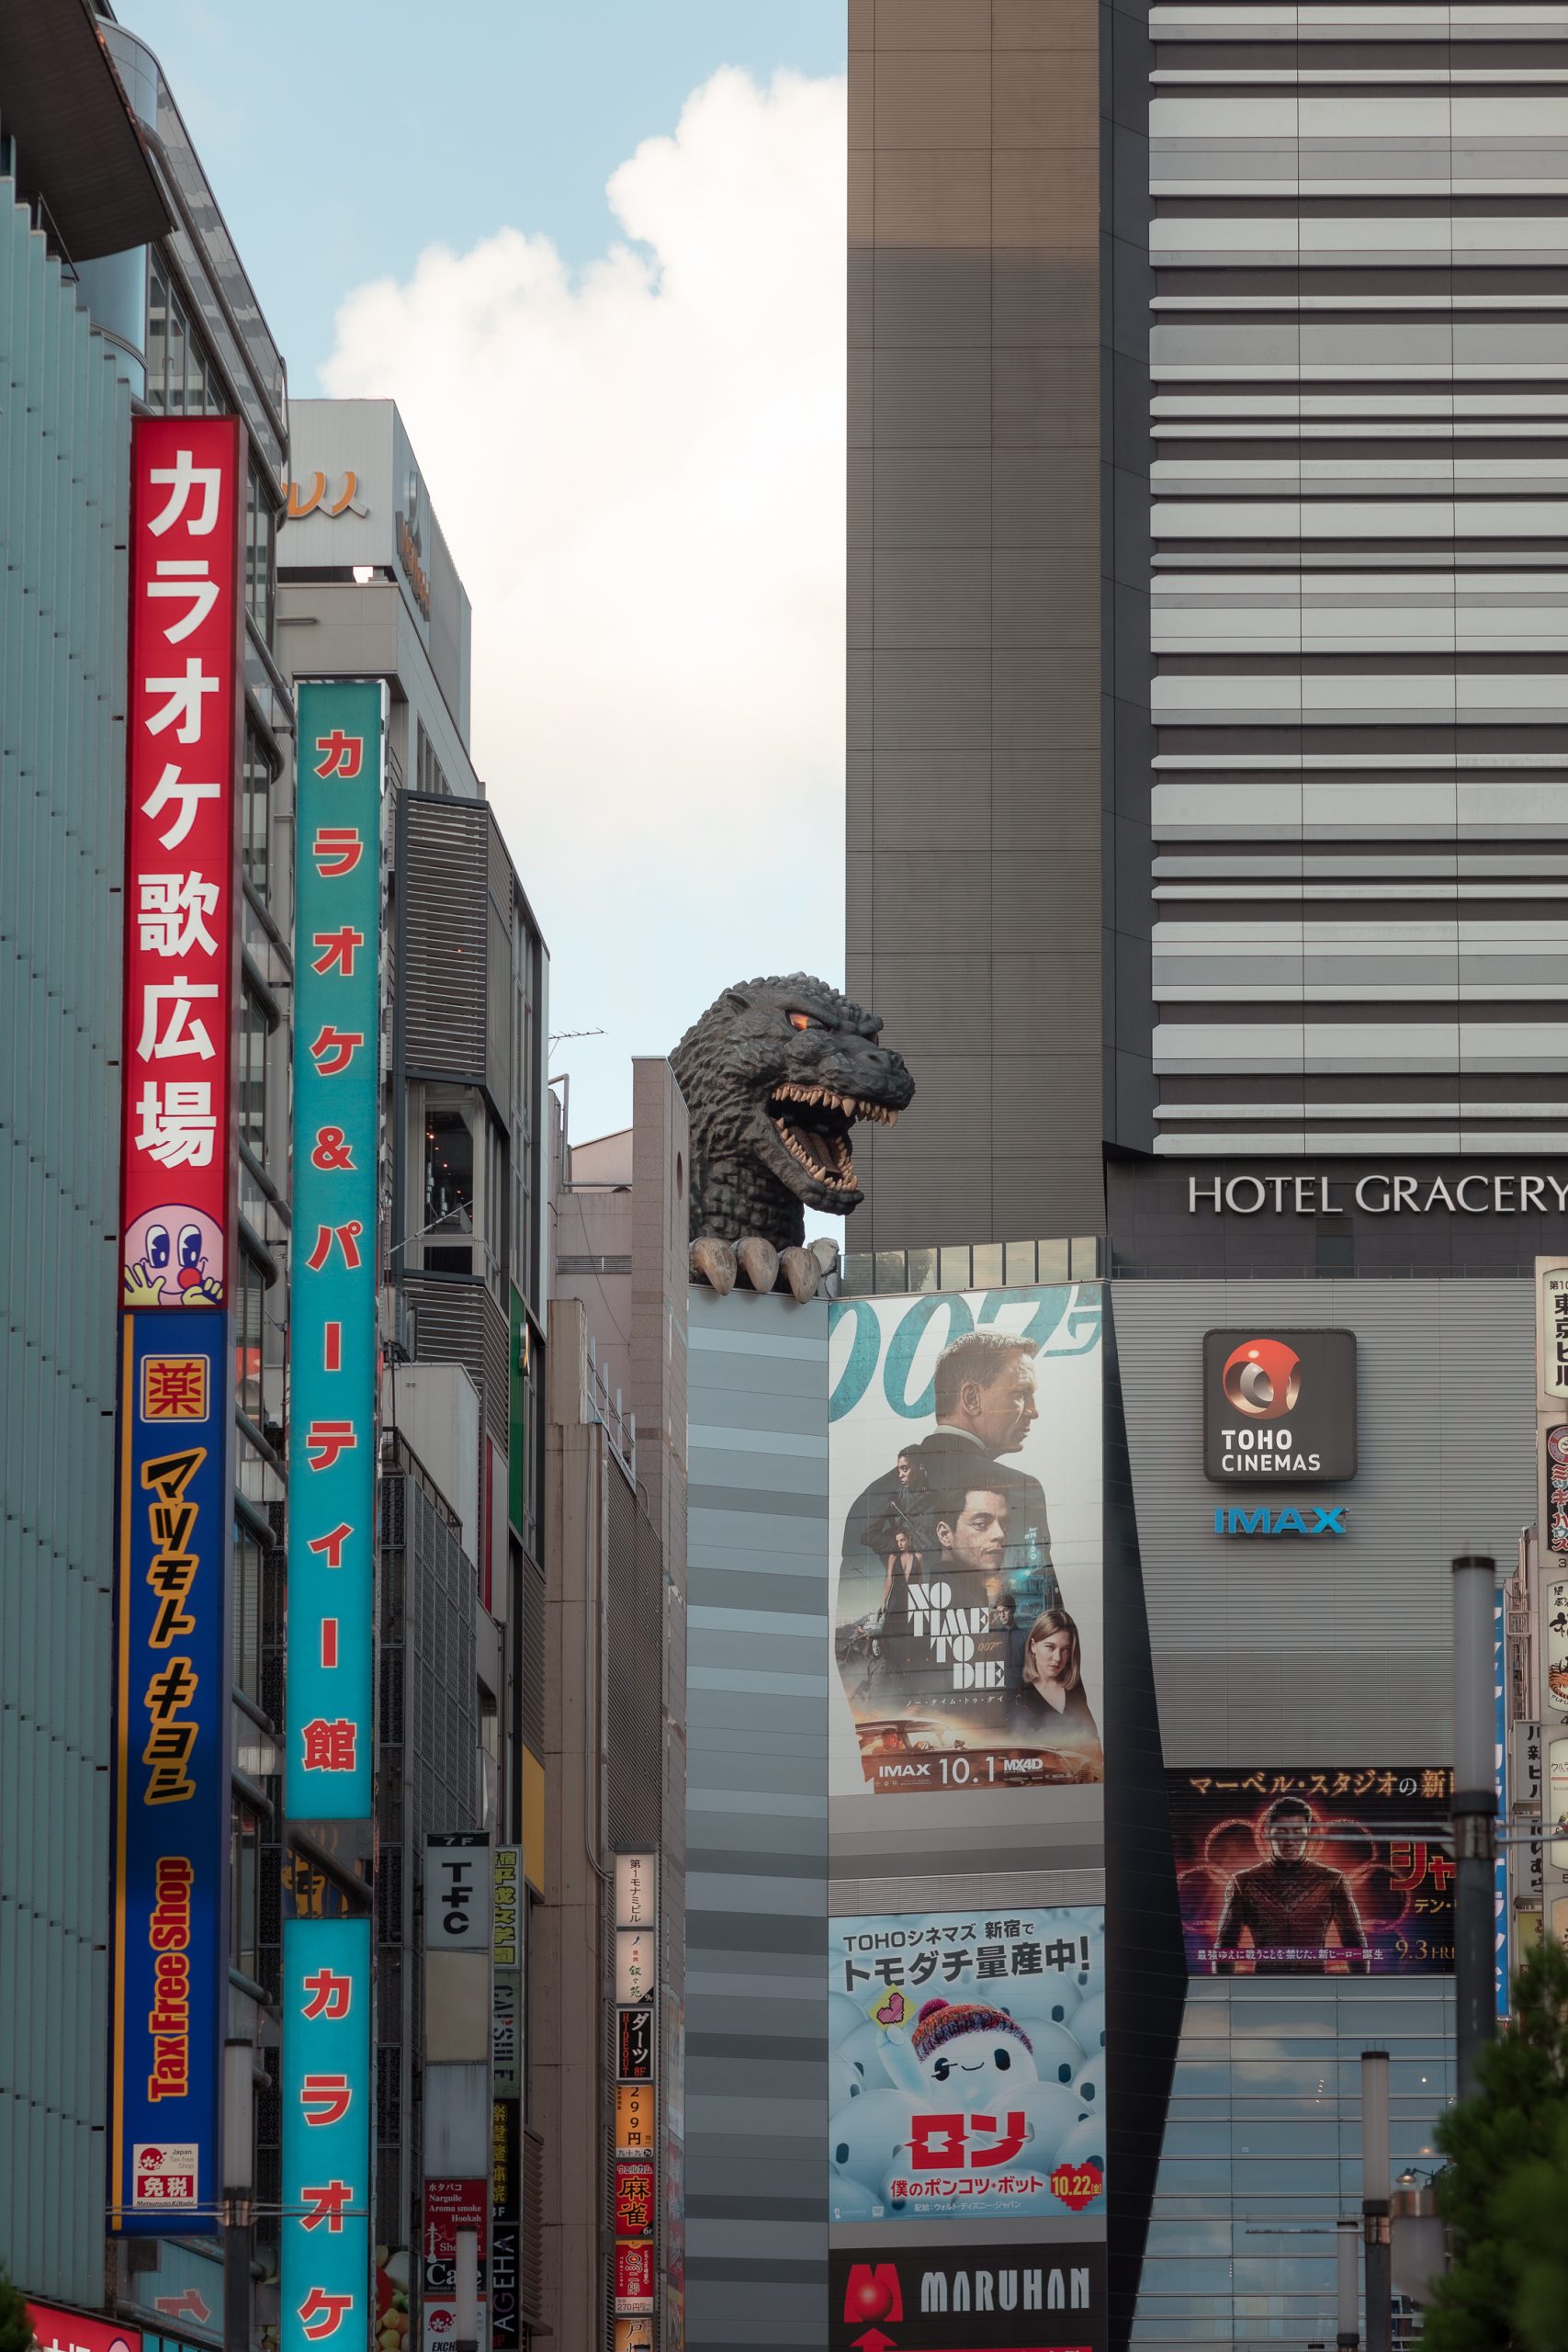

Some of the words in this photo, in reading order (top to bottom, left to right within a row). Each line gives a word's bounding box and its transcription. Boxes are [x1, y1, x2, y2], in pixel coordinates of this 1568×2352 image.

[134, 449, 221, 1169] カラオケ歌広場
[1189, 1175, 1343, 1214] HOTEL
[1354, 1174, 1568, 1213] GRACERY
[148, 1363, 201, 1415] 薬
[1221, 1430, 1292, 1450] TOHO
[1221, 1453, 1321, 1472] CINEMAS
[1214, 1507, 1348, 1534] IMAX
[908, 1581, 952, 1610] NO
[141, 1447, 207, 1805] マツモトキヨシ
[908, 1607, 989, 1636] TIME
[931, 1634, 975, 1663] TO
[953, 1661, 1006, 1690] DIE
[878, 1763, 931, 1778] IMAX
[1003, 1758, 1044, 1773] MX4D
[1190, 1769, 1455, 1798] マーベル・スタジオの新
[149, 1856, 194, 1951] Shop
[842, 1923, 976, 1952] TOHOシネマズ
[985, 1918, 1035, 1939] 新宿で
[1394, 1939, 1427, 1961] 9.3
[844, 1935, 1090, 1992] トモダチ量産中!
[150, 1951, 190, 2034] Free
[622, 2013, 630, 2077] HIDEOUT
[631, 2013, 649, 2064] ダーツ
[147, 2030, 189, 2103] Tax
[298, 1969, 354, 2340] カラオケ
[904, 2111, 1030, 2170] ロン
[144, 2177, 187, 2198] 免税
[617, 2176, 651, 2227] 麻雀
[451, 2214, 481, 2222] Hookah
[457, 2204, 482, 2212] smoke
[493, 2234, 514, 2334] AGEHA
[920, 2267, 1089, 2312] MARUHAN
